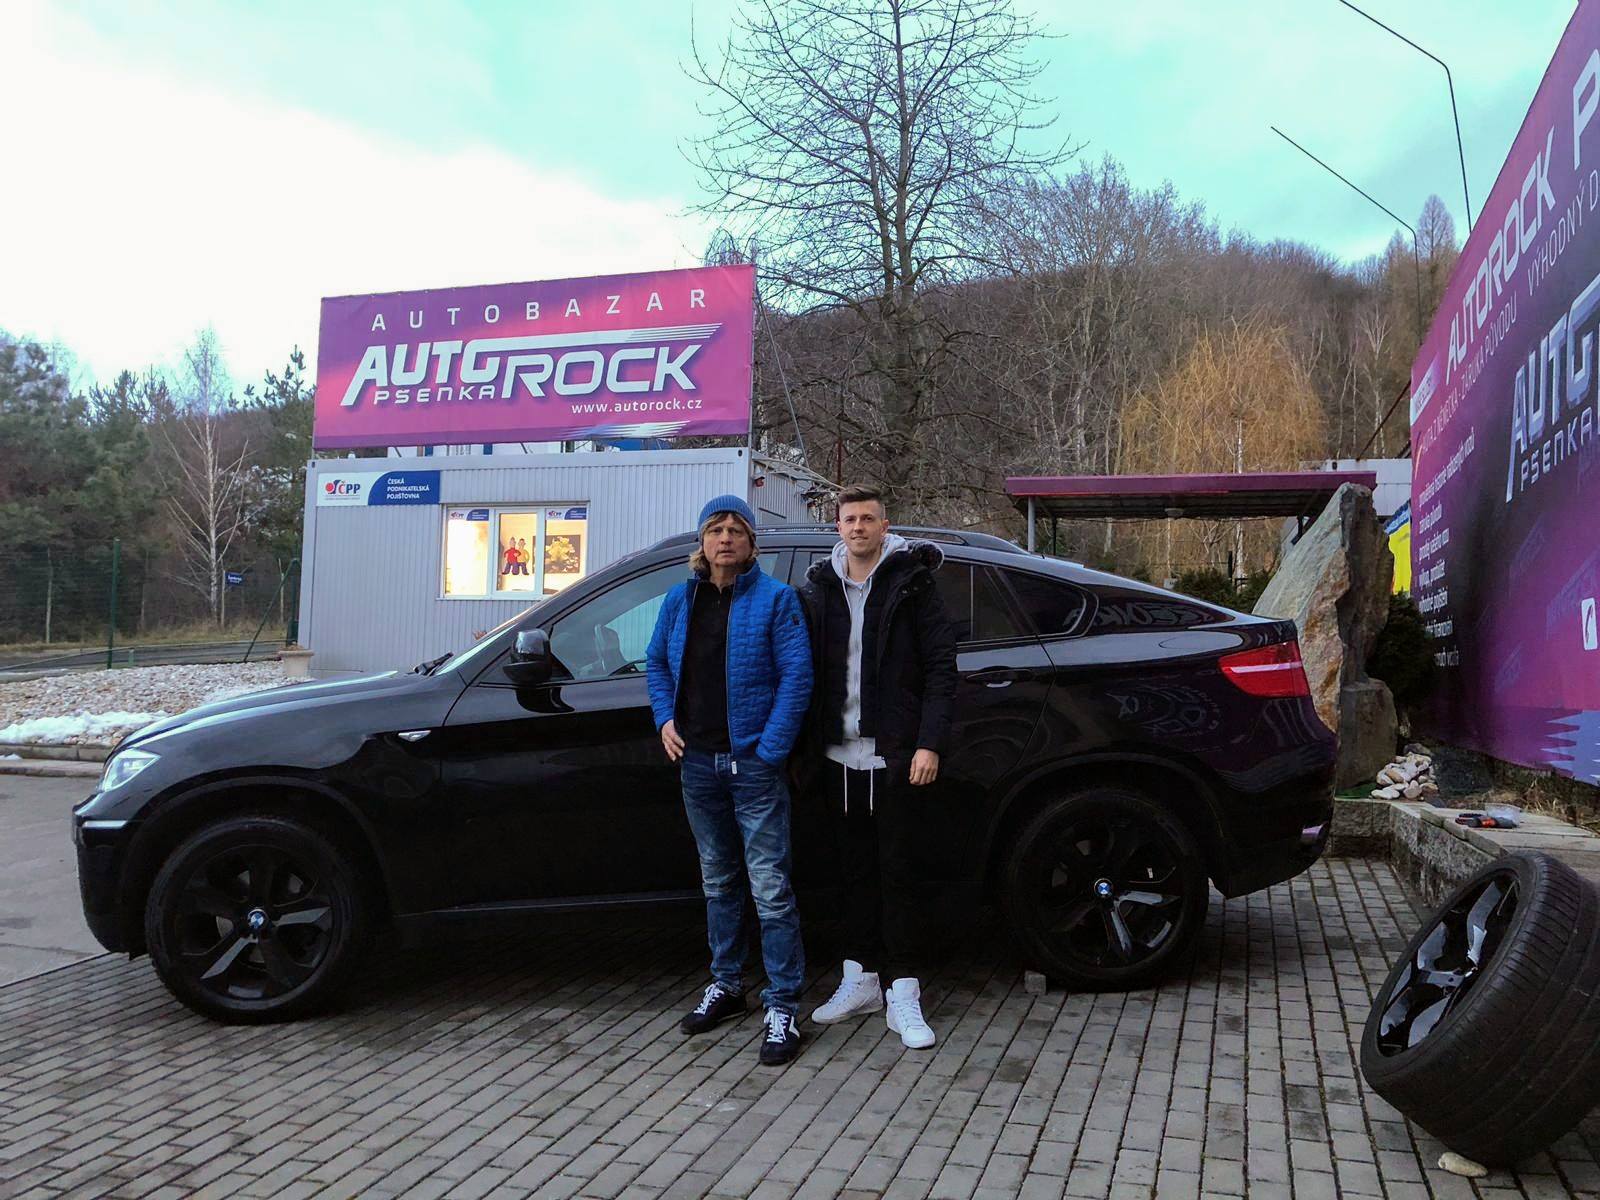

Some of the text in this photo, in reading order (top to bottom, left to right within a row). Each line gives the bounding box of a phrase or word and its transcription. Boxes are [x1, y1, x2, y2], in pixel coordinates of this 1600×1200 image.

[1446, 125, 1556, 386] AUTOROCK
[1485, 290, 1517, 362] PŮVODU
[1527, 179, 1585, 296] VÝHODNÝ
[371, 288, 705, 332] AUTOBAZAR
[340, 325, 716, 406] AUTOROCK
[1505, 273, 1600, 503] AUTO
[571, 398, 703, 415] www.autorock.cz
[338, 480, 361, 495] ČPP
